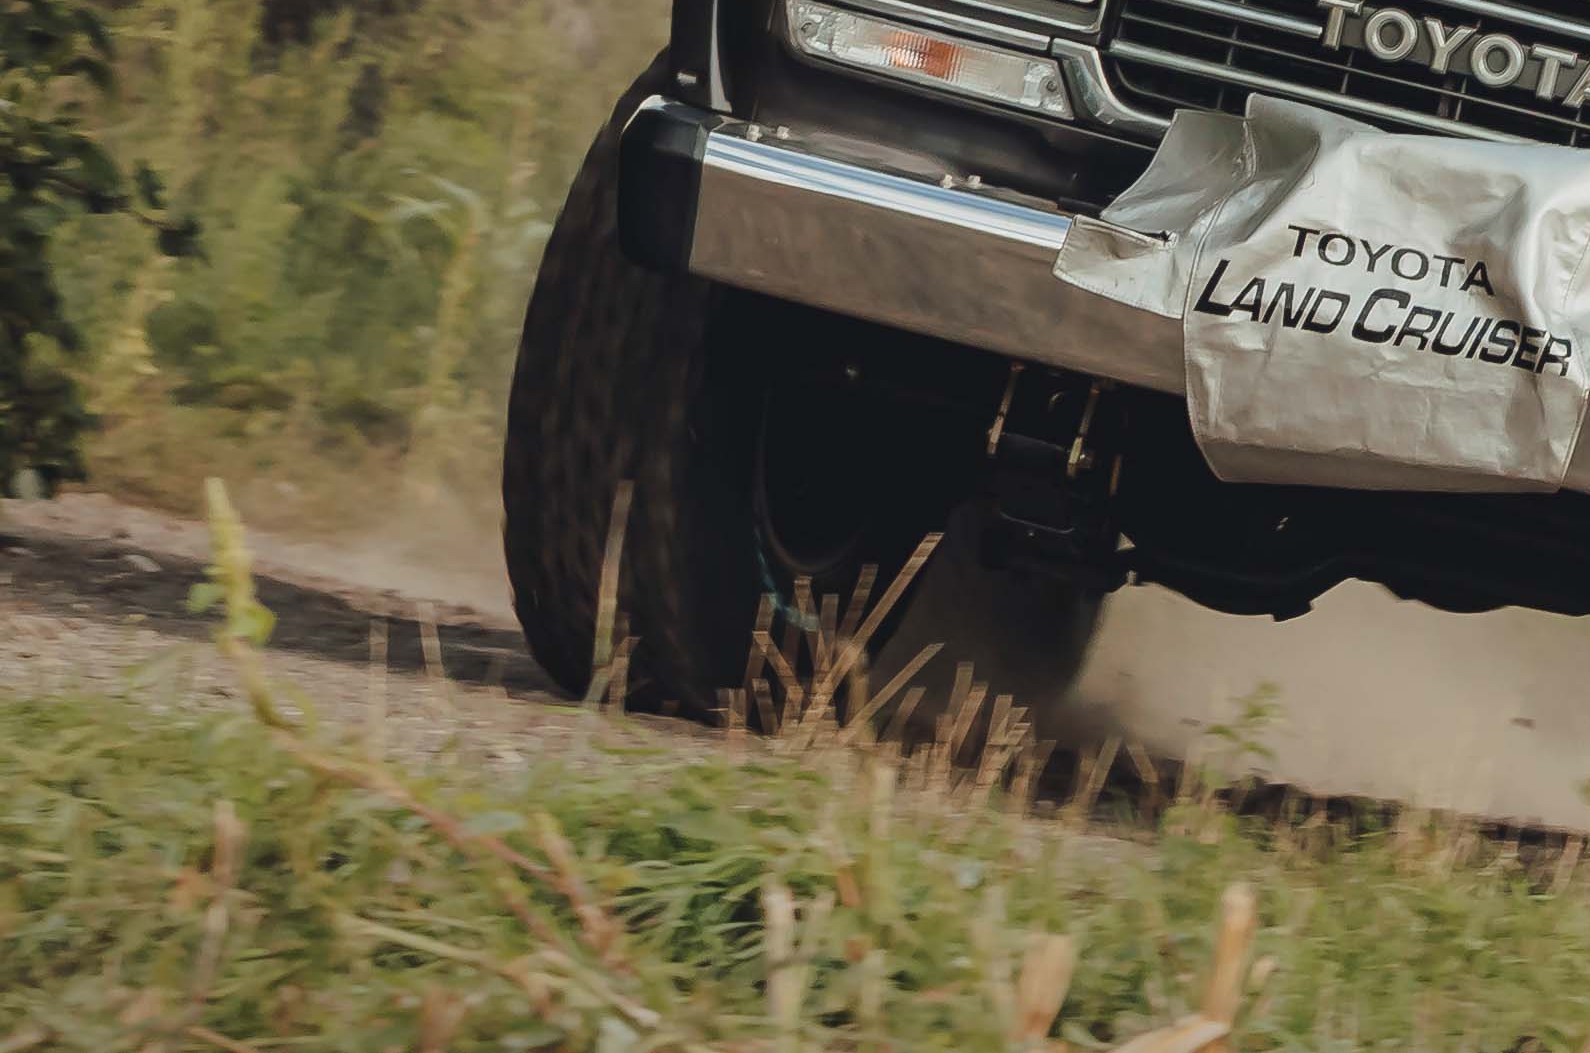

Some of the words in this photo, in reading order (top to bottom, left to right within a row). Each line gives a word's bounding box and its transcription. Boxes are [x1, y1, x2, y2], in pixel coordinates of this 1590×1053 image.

[1288, 224, 1496, 297] TOYOTA
[1193, 259, 1351, 335] LAND
[1351, 288, 1572, 377] CRUISER
